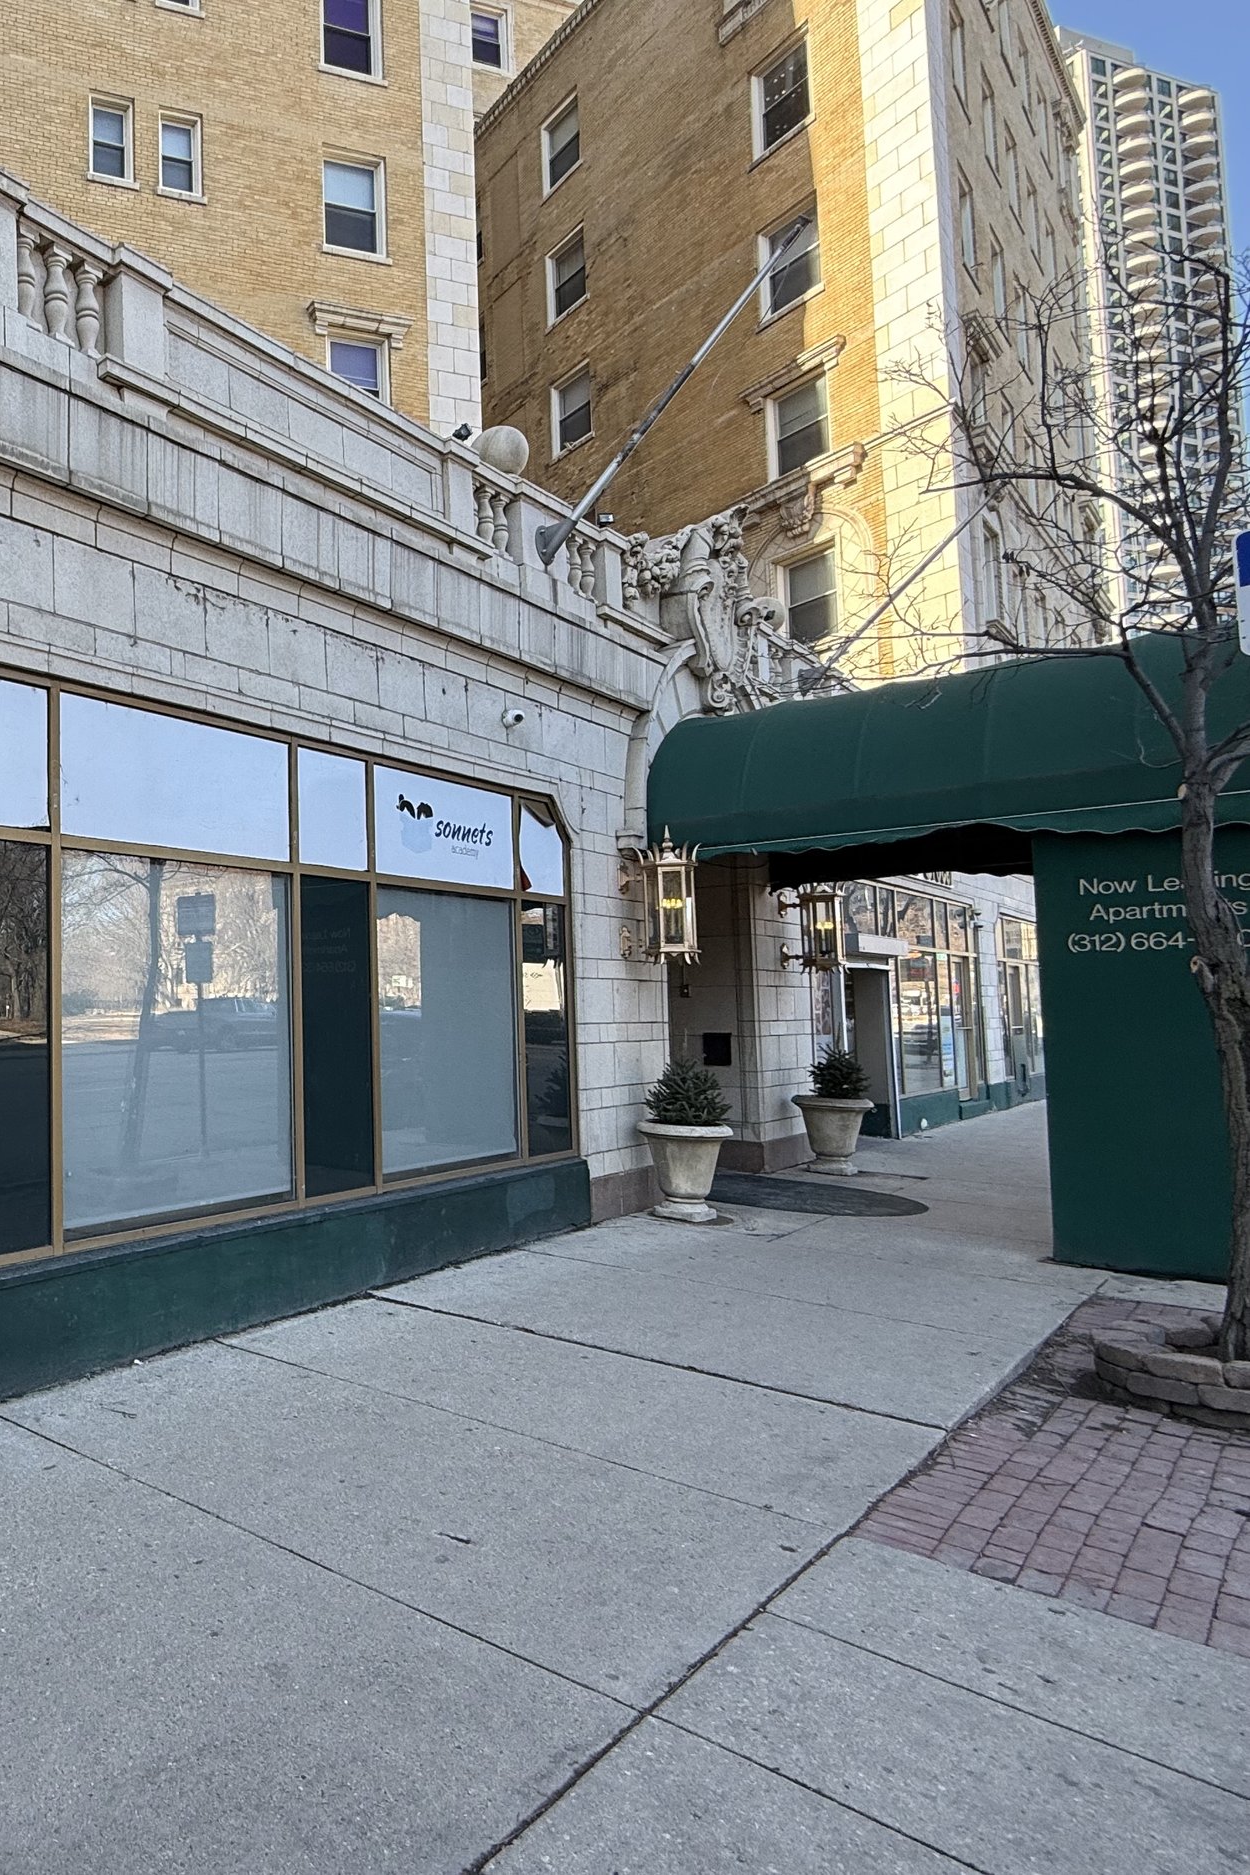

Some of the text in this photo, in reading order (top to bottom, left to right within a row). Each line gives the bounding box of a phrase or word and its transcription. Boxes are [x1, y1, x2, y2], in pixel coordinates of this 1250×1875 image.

[434, 819, 494, 847] sonnets
[1079, 870, 1250, 896] Now Leing
[1089, 901, 1248, 924] Apartms
[1067, 932, 1126, 953] (312)
